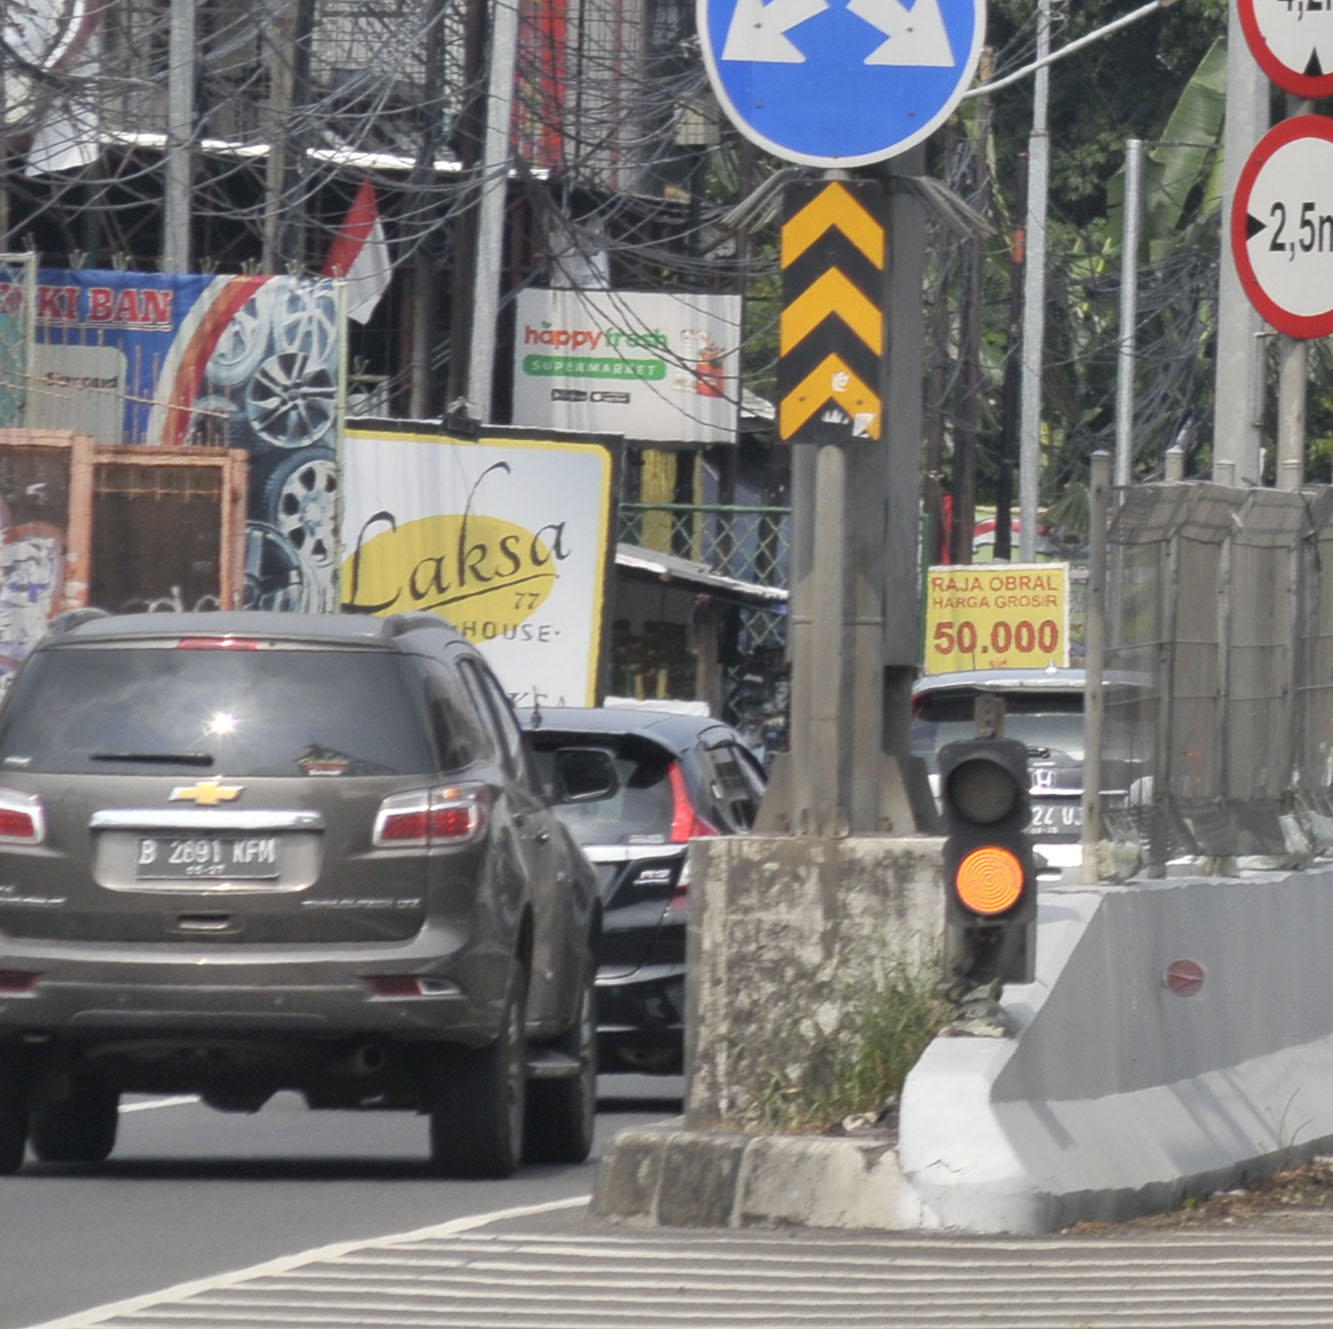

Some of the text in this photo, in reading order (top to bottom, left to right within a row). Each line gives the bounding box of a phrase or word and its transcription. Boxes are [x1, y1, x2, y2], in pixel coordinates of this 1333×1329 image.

[87, 286, 175, 326] BAN
[531, 360, 657, 377] SUPERMARKET
[341, 460, 571, 615] Laksa
[931, 575, 1058, 593] RAJA OBRAL
[933, 594, 1058, 609] HARGA GROSIR
[934, 619, 1059, 655] 50.000
[138, 839, 157, 865] B
[232, 837, 277, 864] KFM
